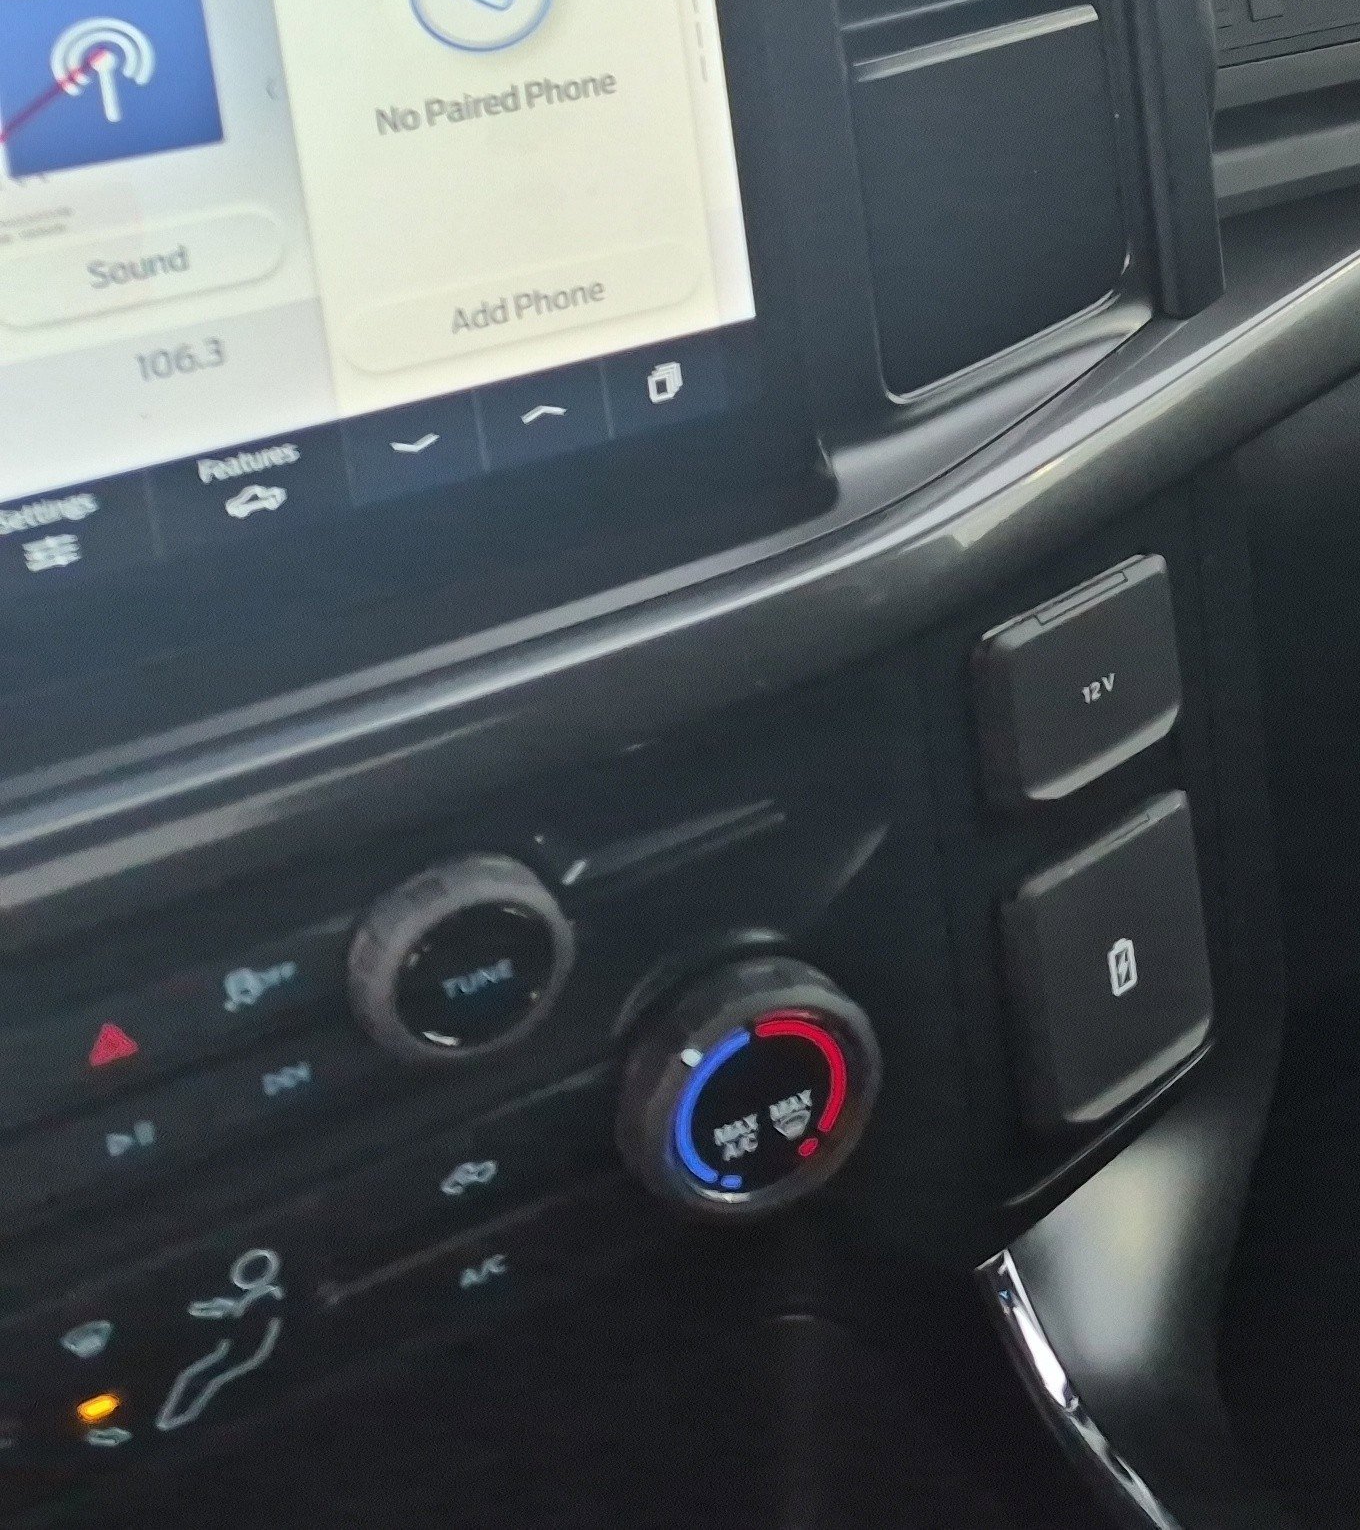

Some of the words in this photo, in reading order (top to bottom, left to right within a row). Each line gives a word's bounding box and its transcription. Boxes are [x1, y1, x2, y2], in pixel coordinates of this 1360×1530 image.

[375, 105, 421, 135] No
[424, 84, 521, 126] Paired
[524, 72, 617, 108] Phone
[87, 245, 190, 290] Sound
[451, 297, 508, 334] Add
[514, 276, 605, 320] Phone
[136, 337, 228, 382] 106.3
[197, 443, 300, 484] Features
[0, 493, 99, 536] Settings
[443, 957, 514, 1000] TUNE
[769, 1088, 812, 1121] MAX
[714, 1113, 758, 1146] MAX
